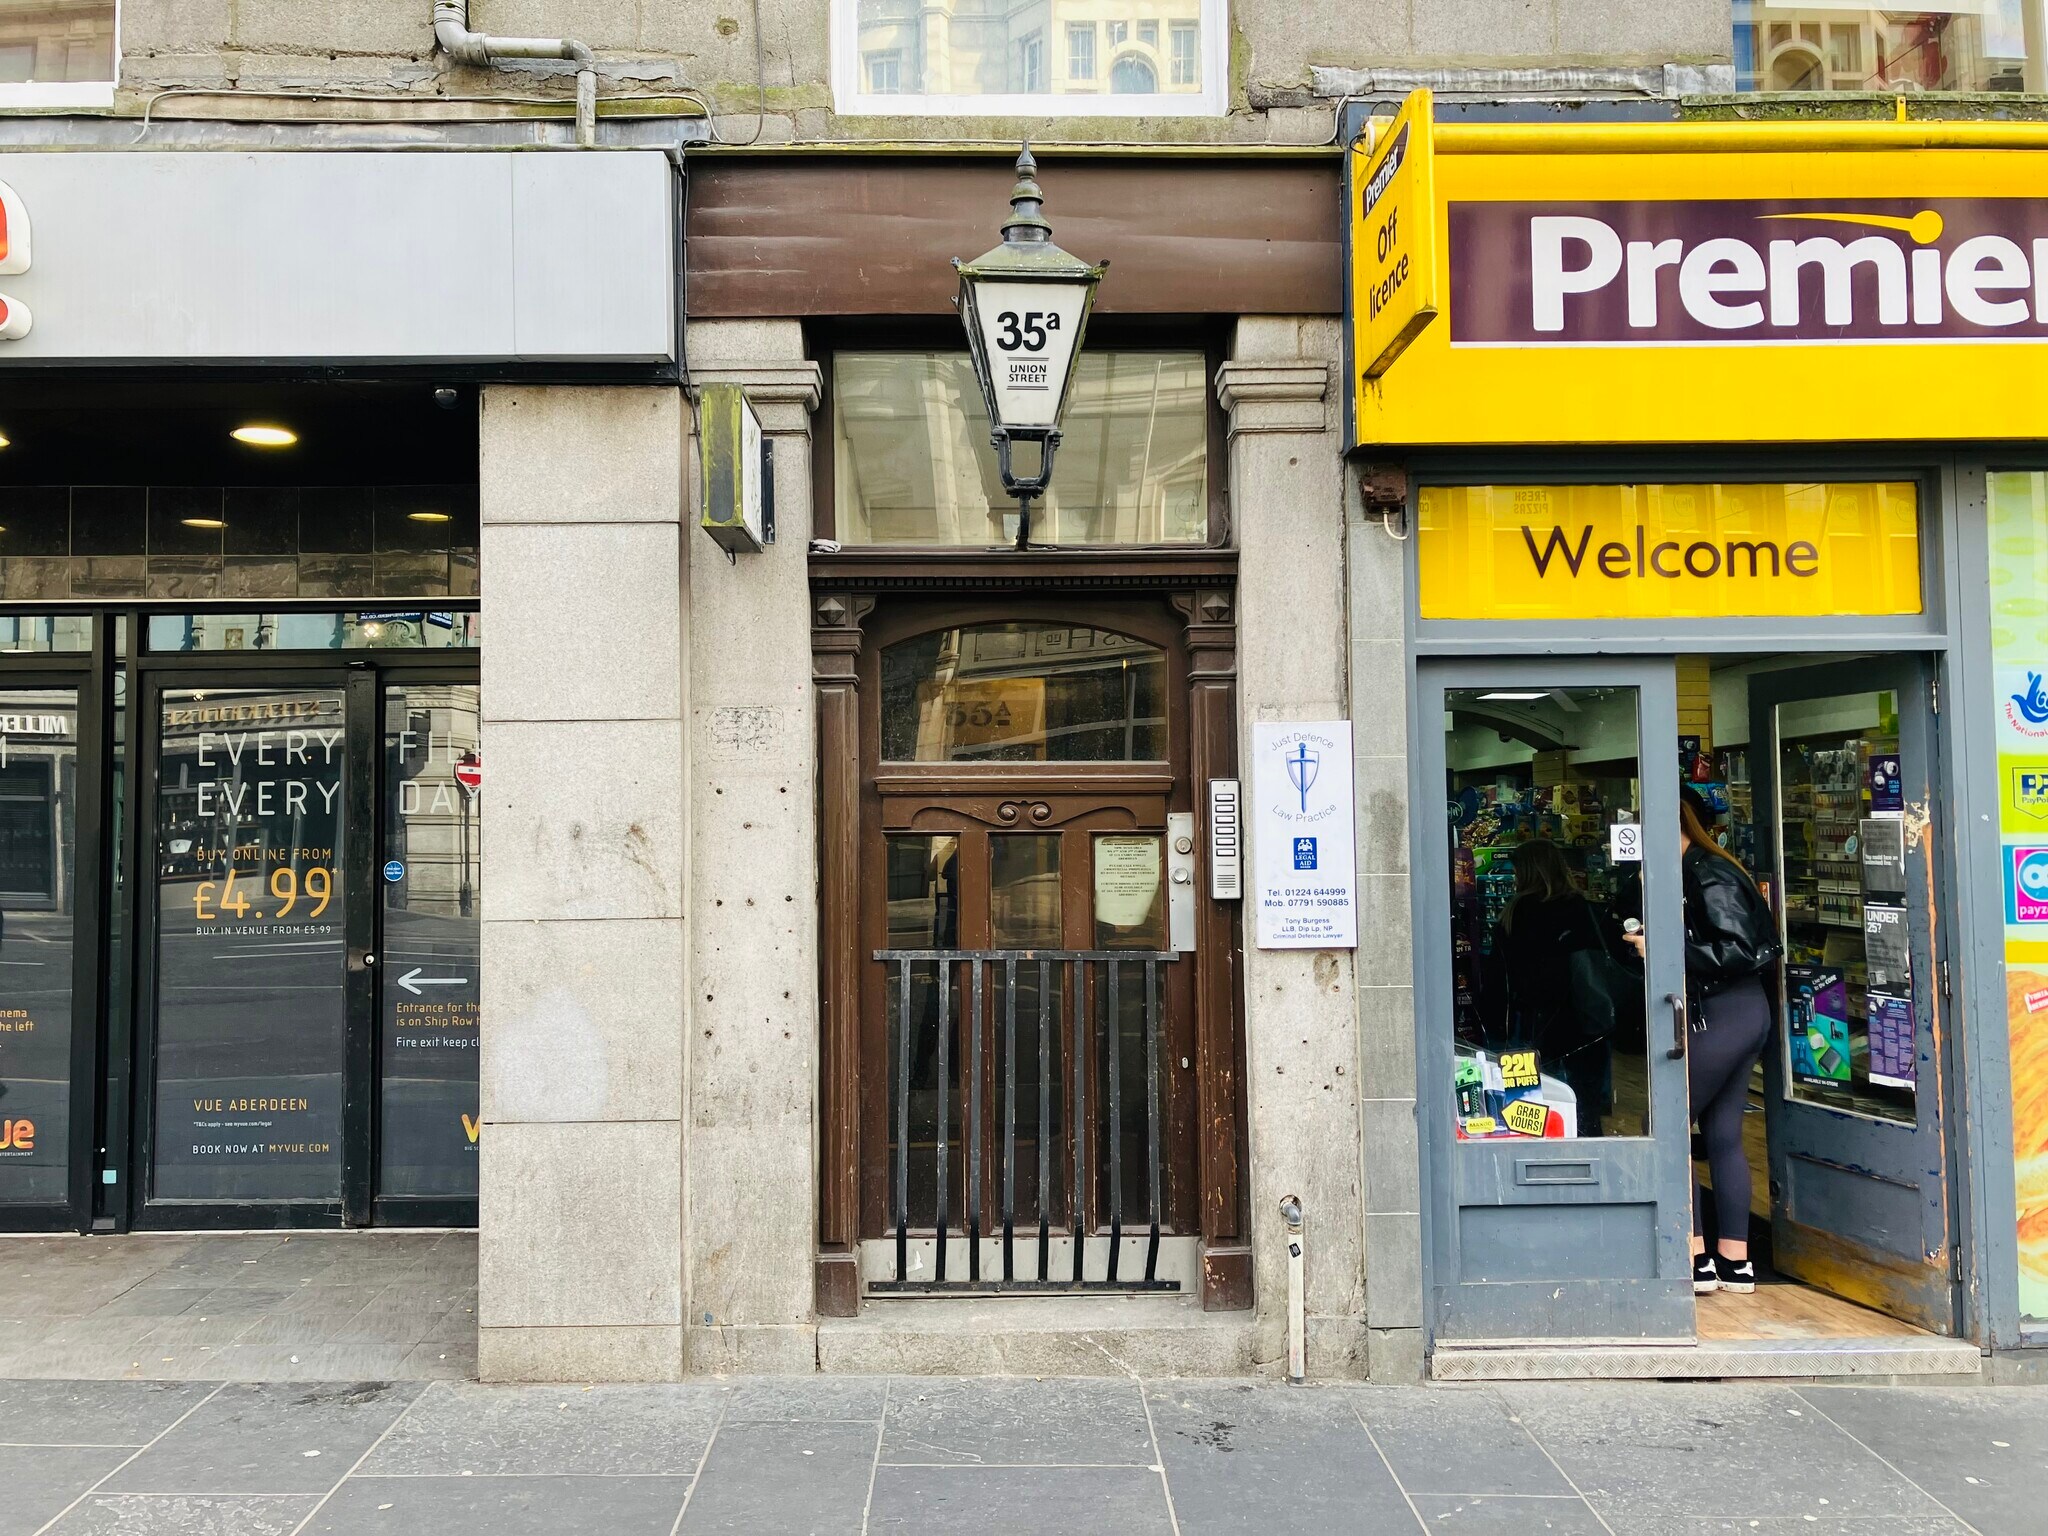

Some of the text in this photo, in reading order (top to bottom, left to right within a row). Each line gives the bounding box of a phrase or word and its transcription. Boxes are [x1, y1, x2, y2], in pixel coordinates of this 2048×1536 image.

[1366, 145, 1399, 213] Premier
[1378, 205, 1398, 263] Off
[1531, 211, 2048, 331] Premie
[1369, 253, 1409, 322] licence
[1010, 364, 1047, 373] UNION
[1008, 373, 1047, 383] STREET
[1521, 525, 1820, 579] Welcome
[2004, 702, 2014, 720] The
[198, 731, 480, 767] EVERY FIL
[1272, 732, 1334, 752] Just Defence
[198, 780, 341, 817] EVERY
[1272, 803, 1337, 823] Law Practice
[197, 848, 332, 861] BUY ONLINE FROM
[1314, 888, 1346, 896] 644999
[1867, 910, 1898, 924] UNDER
[196, 925, 332, 936] BUY IN VENUE FROM £5.99
[1867, 922, 1882, 934] 25?
[396, 1002, 443, 1013] Entrance
[447, 1002, 462, 1013] for
[16, 1020, 34, 1032] left
[396, 1016, 405, 1026] is
[408, 1018, 421, 1026] on
[424, 1016, 448, 1028] Ship
[452, 1016, 472, 1026] Row
[396, 1036, 416, 1047] Fire
[420, 1036, 440, 1047] exit
[443, 1036, 468, 1050] keep
[1500, 1052, 1538, 1078] 22K
[1516, 1075, 1539, 1088] PUFFS
[194, 1098, 308, 1112] VUE ABERDEEN
[1516, 1104, 1541, 1120] GRAB
[1510, 1115, 1543, 1132] YOURS!
[192, 1144, 330, 1154] BOOK NOW AT MYVUE.COM
